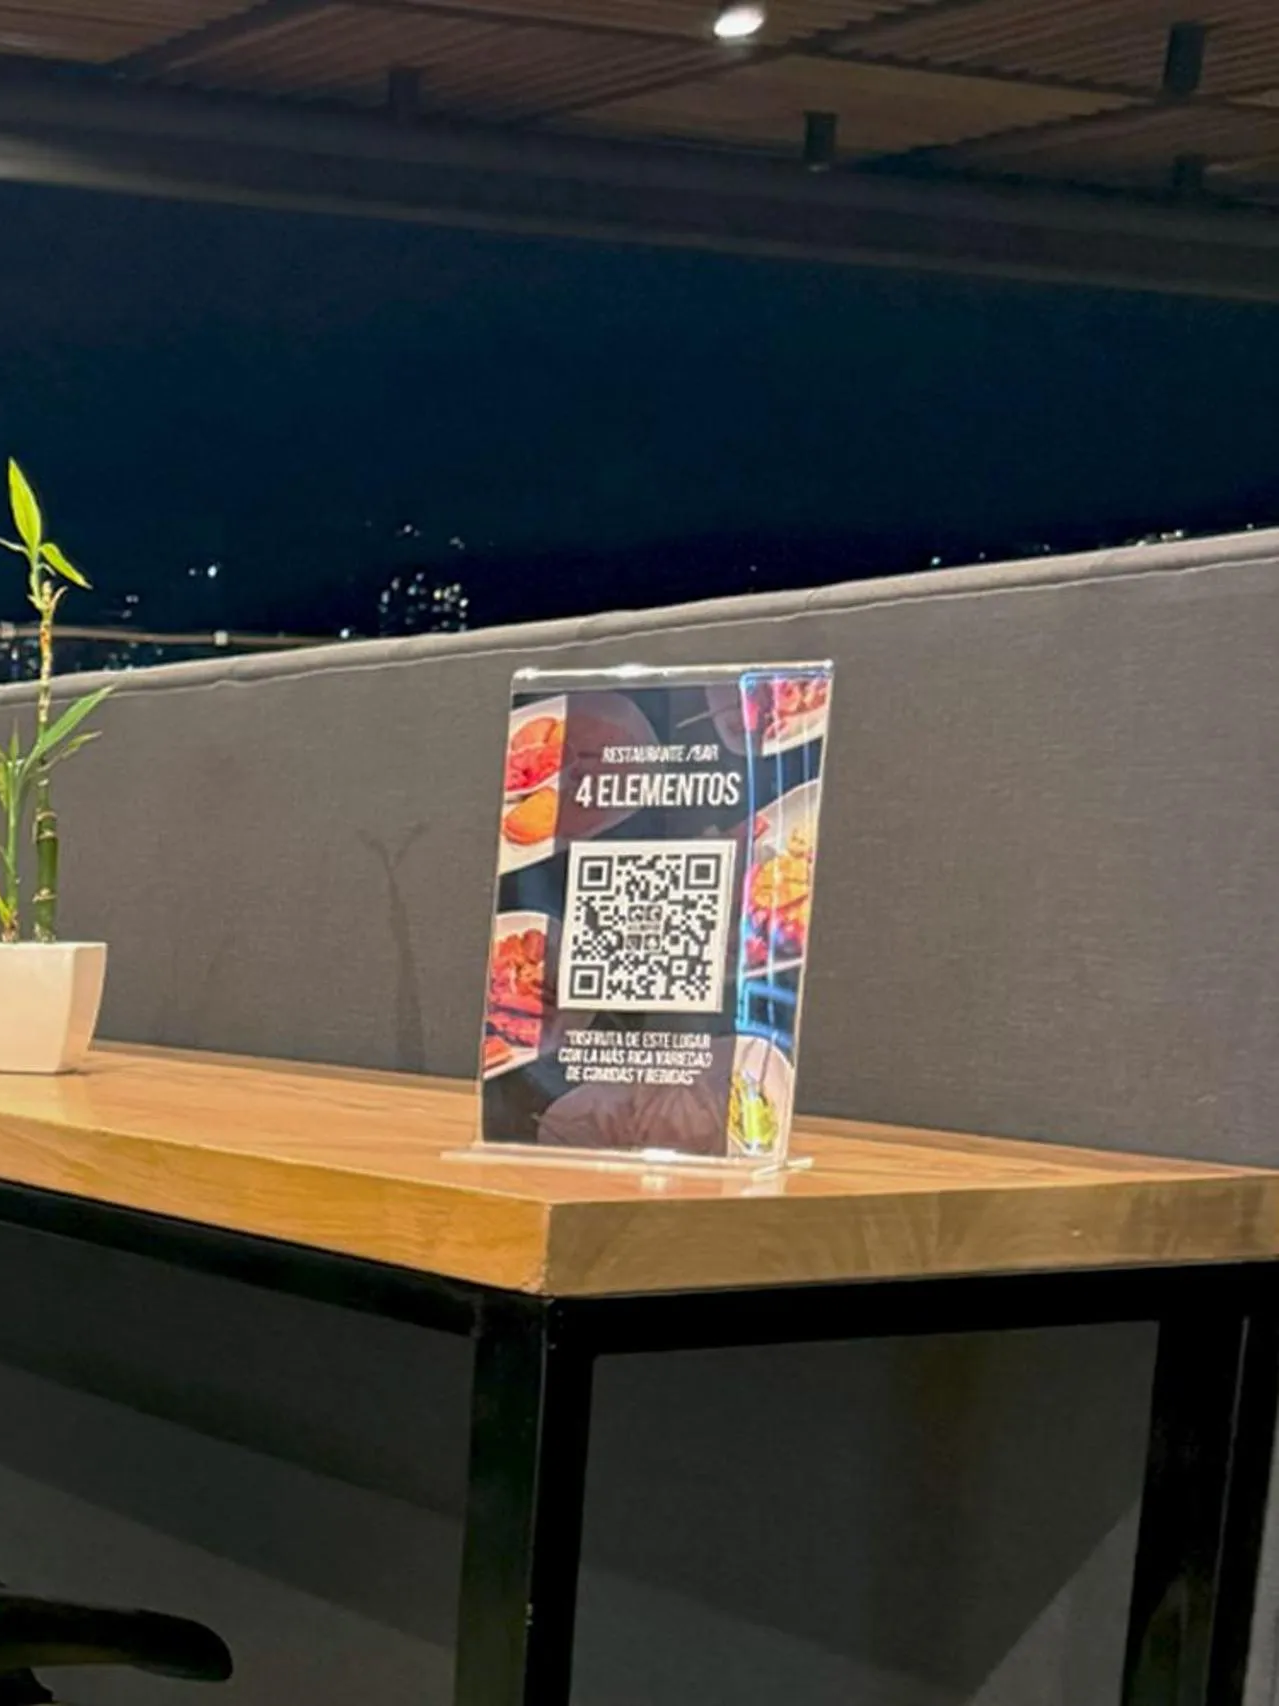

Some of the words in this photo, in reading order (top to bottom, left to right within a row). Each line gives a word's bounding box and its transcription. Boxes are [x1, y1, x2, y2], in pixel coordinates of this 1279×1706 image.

[575, 774, 593, 808] 4
[597, 771, 741, 808] ELEMENTOS
[583, 1048, 598, 1063] LA
